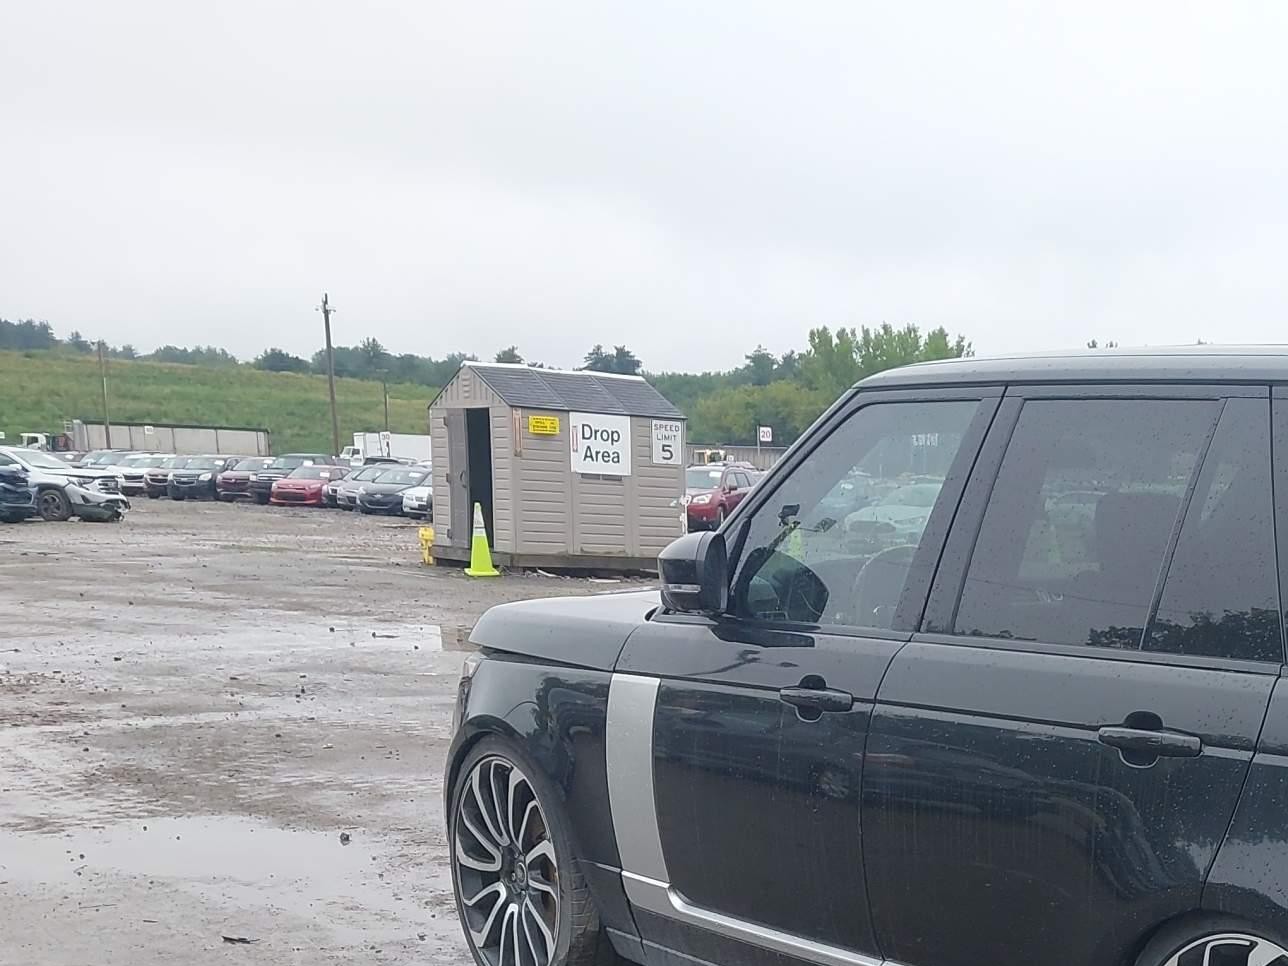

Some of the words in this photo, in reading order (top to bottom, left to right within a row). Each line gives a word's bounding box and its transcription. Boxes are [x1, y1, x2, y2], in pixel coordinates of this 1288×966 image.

[653, 423, 680, 432] SPEED
[581, 424, 620, 446] Drop
[656, 433, 677, 441] LIMIT
[760, 430, 771, 439] 20
[583, 446, 620, 463] Area
[661, 445, 673, 460] 5
